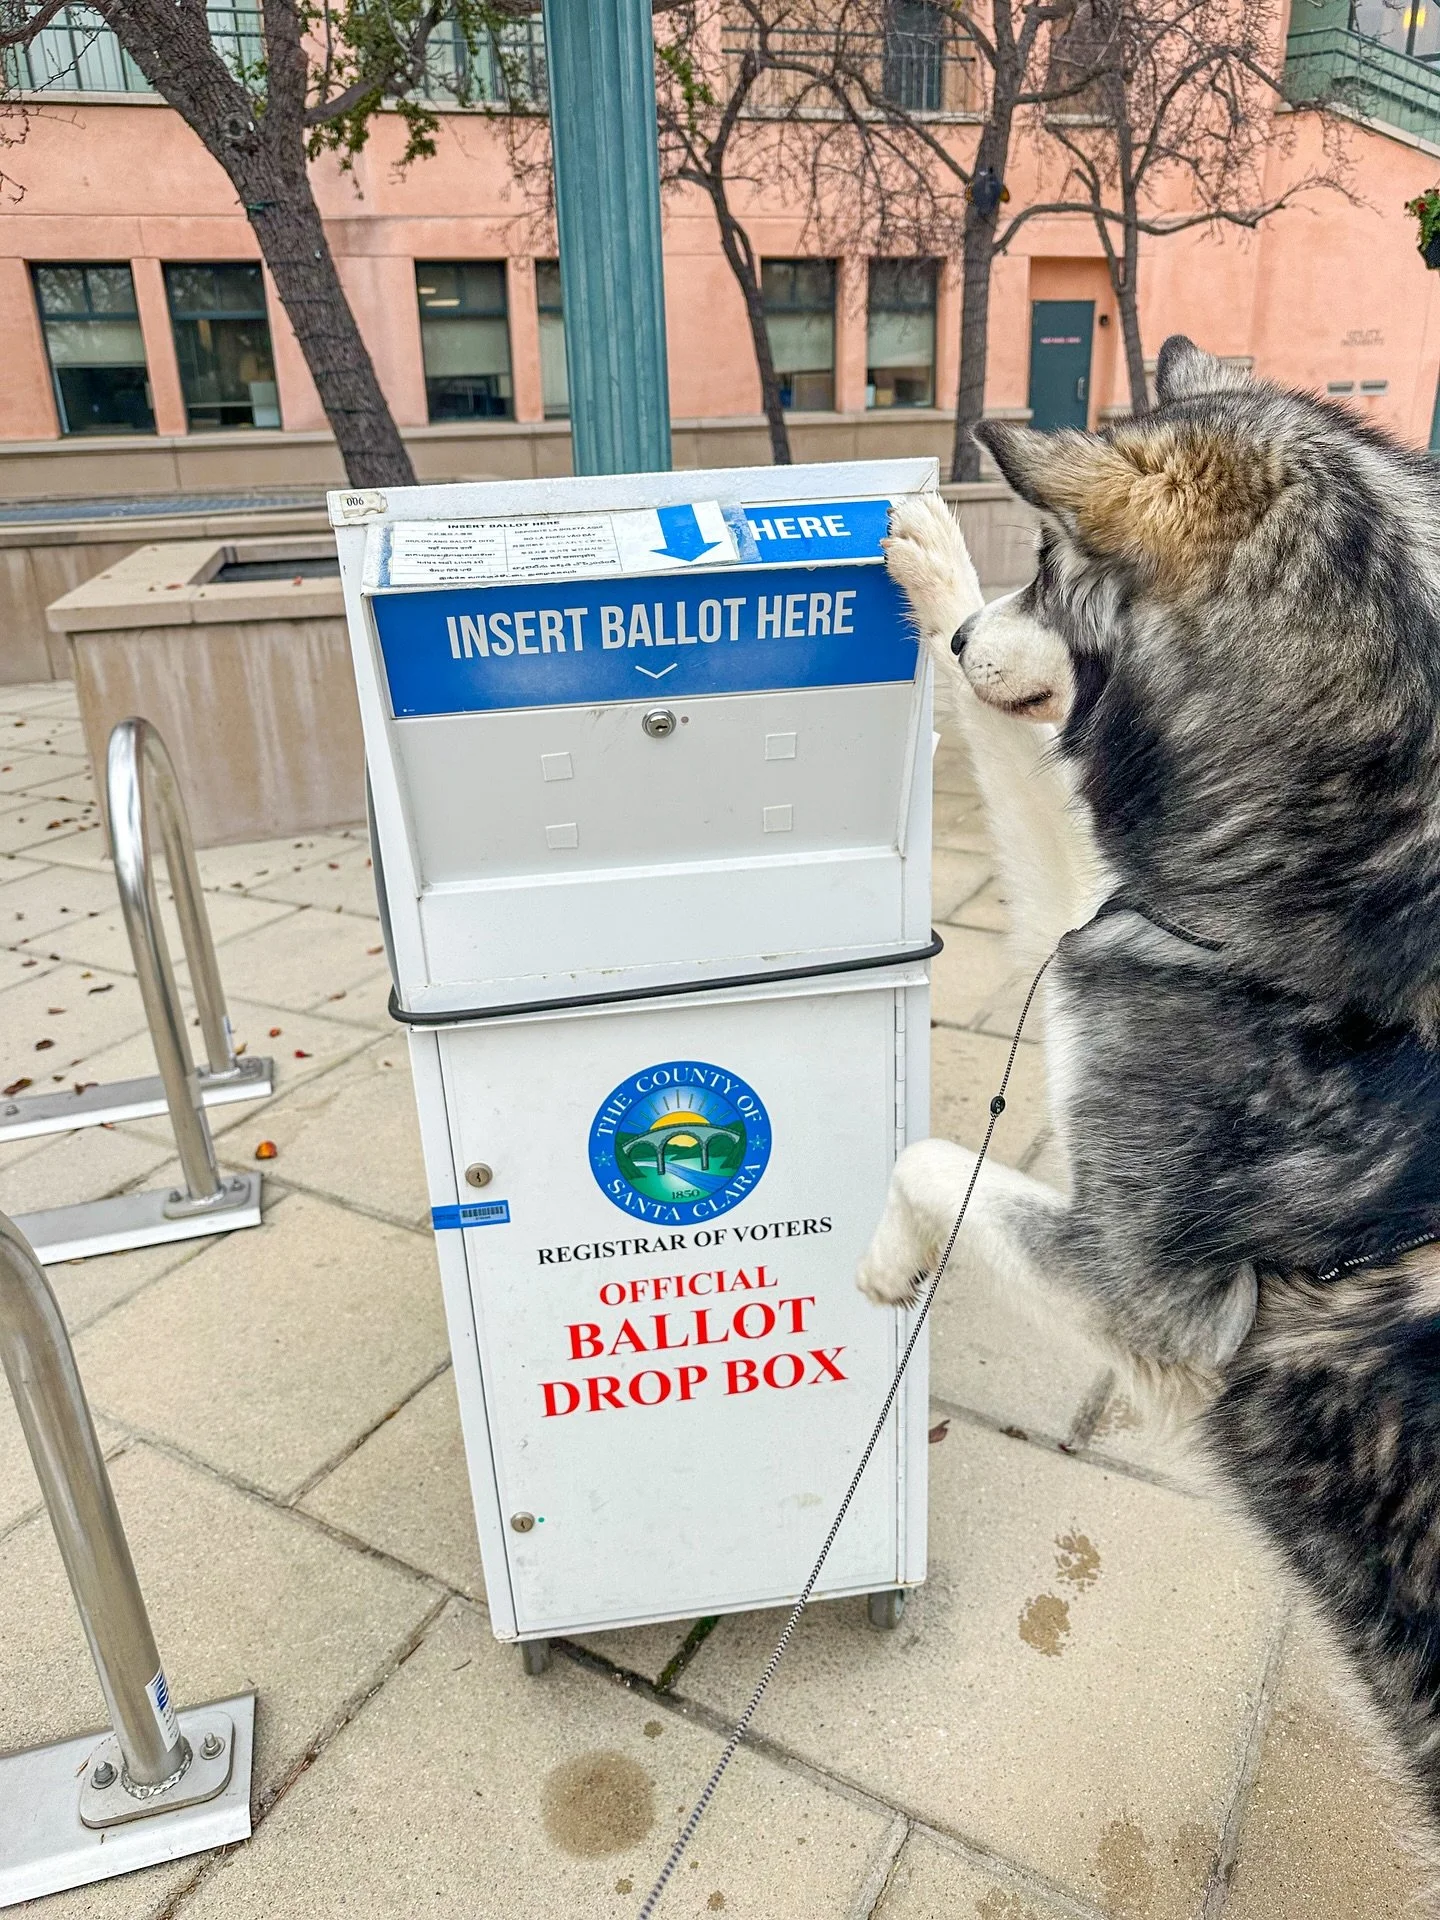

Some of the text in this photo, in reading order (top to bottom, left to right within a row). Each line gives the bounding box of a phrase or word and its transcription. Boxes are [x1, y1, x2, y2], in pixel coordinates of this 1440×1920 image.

[346, 497, 365, 507] 006
[747, 514, 852, 541] HERE
[446, 590, 856, 660] INSERT BALLOT HERE
[596, 1067, 764, 1138] THE COUNTY OF
[607, 1161, 761, 1221] SANTA CLARA
[672, 1188, 700, 1201] 1850
[538, 1217, 833, 1265] REGISTRAR OF VOTERS
[599, 1265, 778, 1306] OFFICIAL
[564, 1296, 816, 1361] BALLOT
[539, 1345, 849, 1417] DROP BOX
